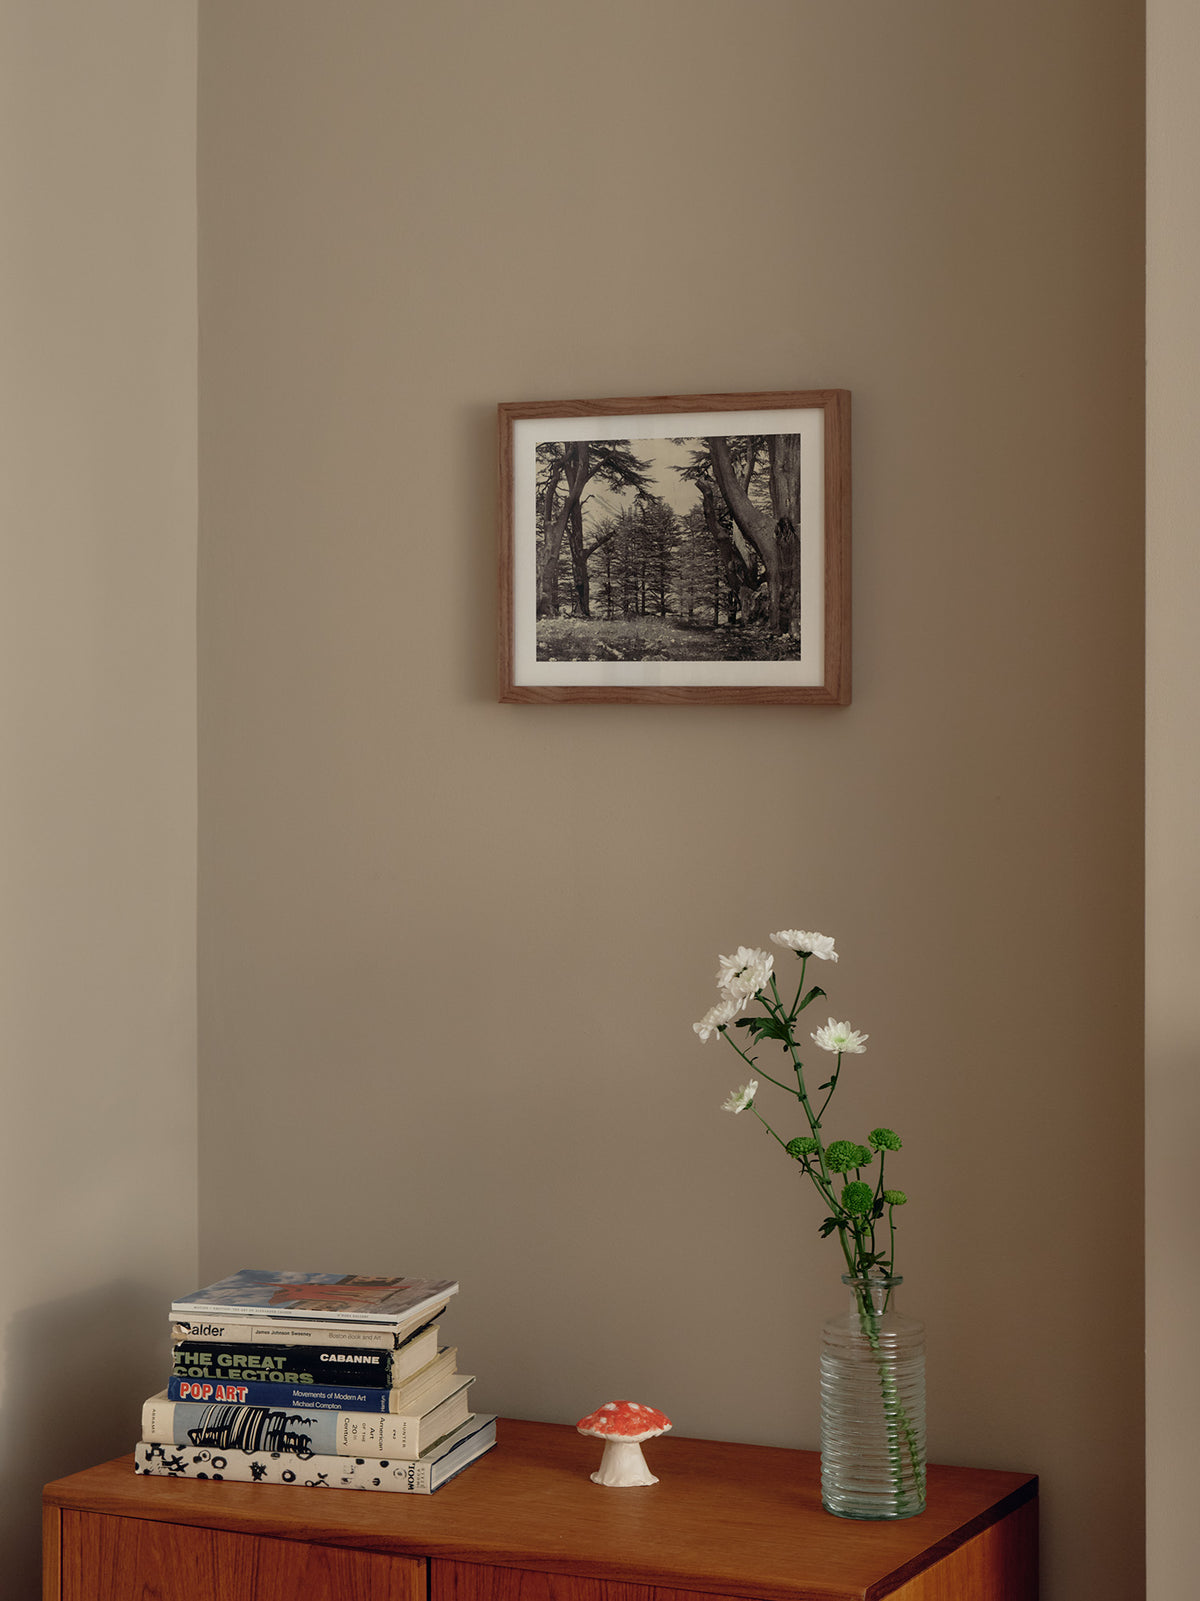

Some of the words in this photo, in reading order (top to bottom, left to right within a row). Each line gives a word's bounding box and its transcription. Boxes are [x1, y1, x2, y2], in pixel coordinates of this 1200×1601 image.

[174, 1351, 213, 1366] THE
[217, 1353, 287, 1369] GREAT
[320, 1353, 380, 1365] CABANNE
[173, 1366, 314, 1384] COLLECTORS
[180, 1382, 213, 1400] POP
[215, 1384, 248, 1403] ART
[292, 1390, 326, 1399] Movements
[334, 1392, 356, 1400] Modern
[292, 1400, 315, 1408] Michael
[315, 1401, 342, 1410] Compton
[378, 1416, 386, 1451] American
